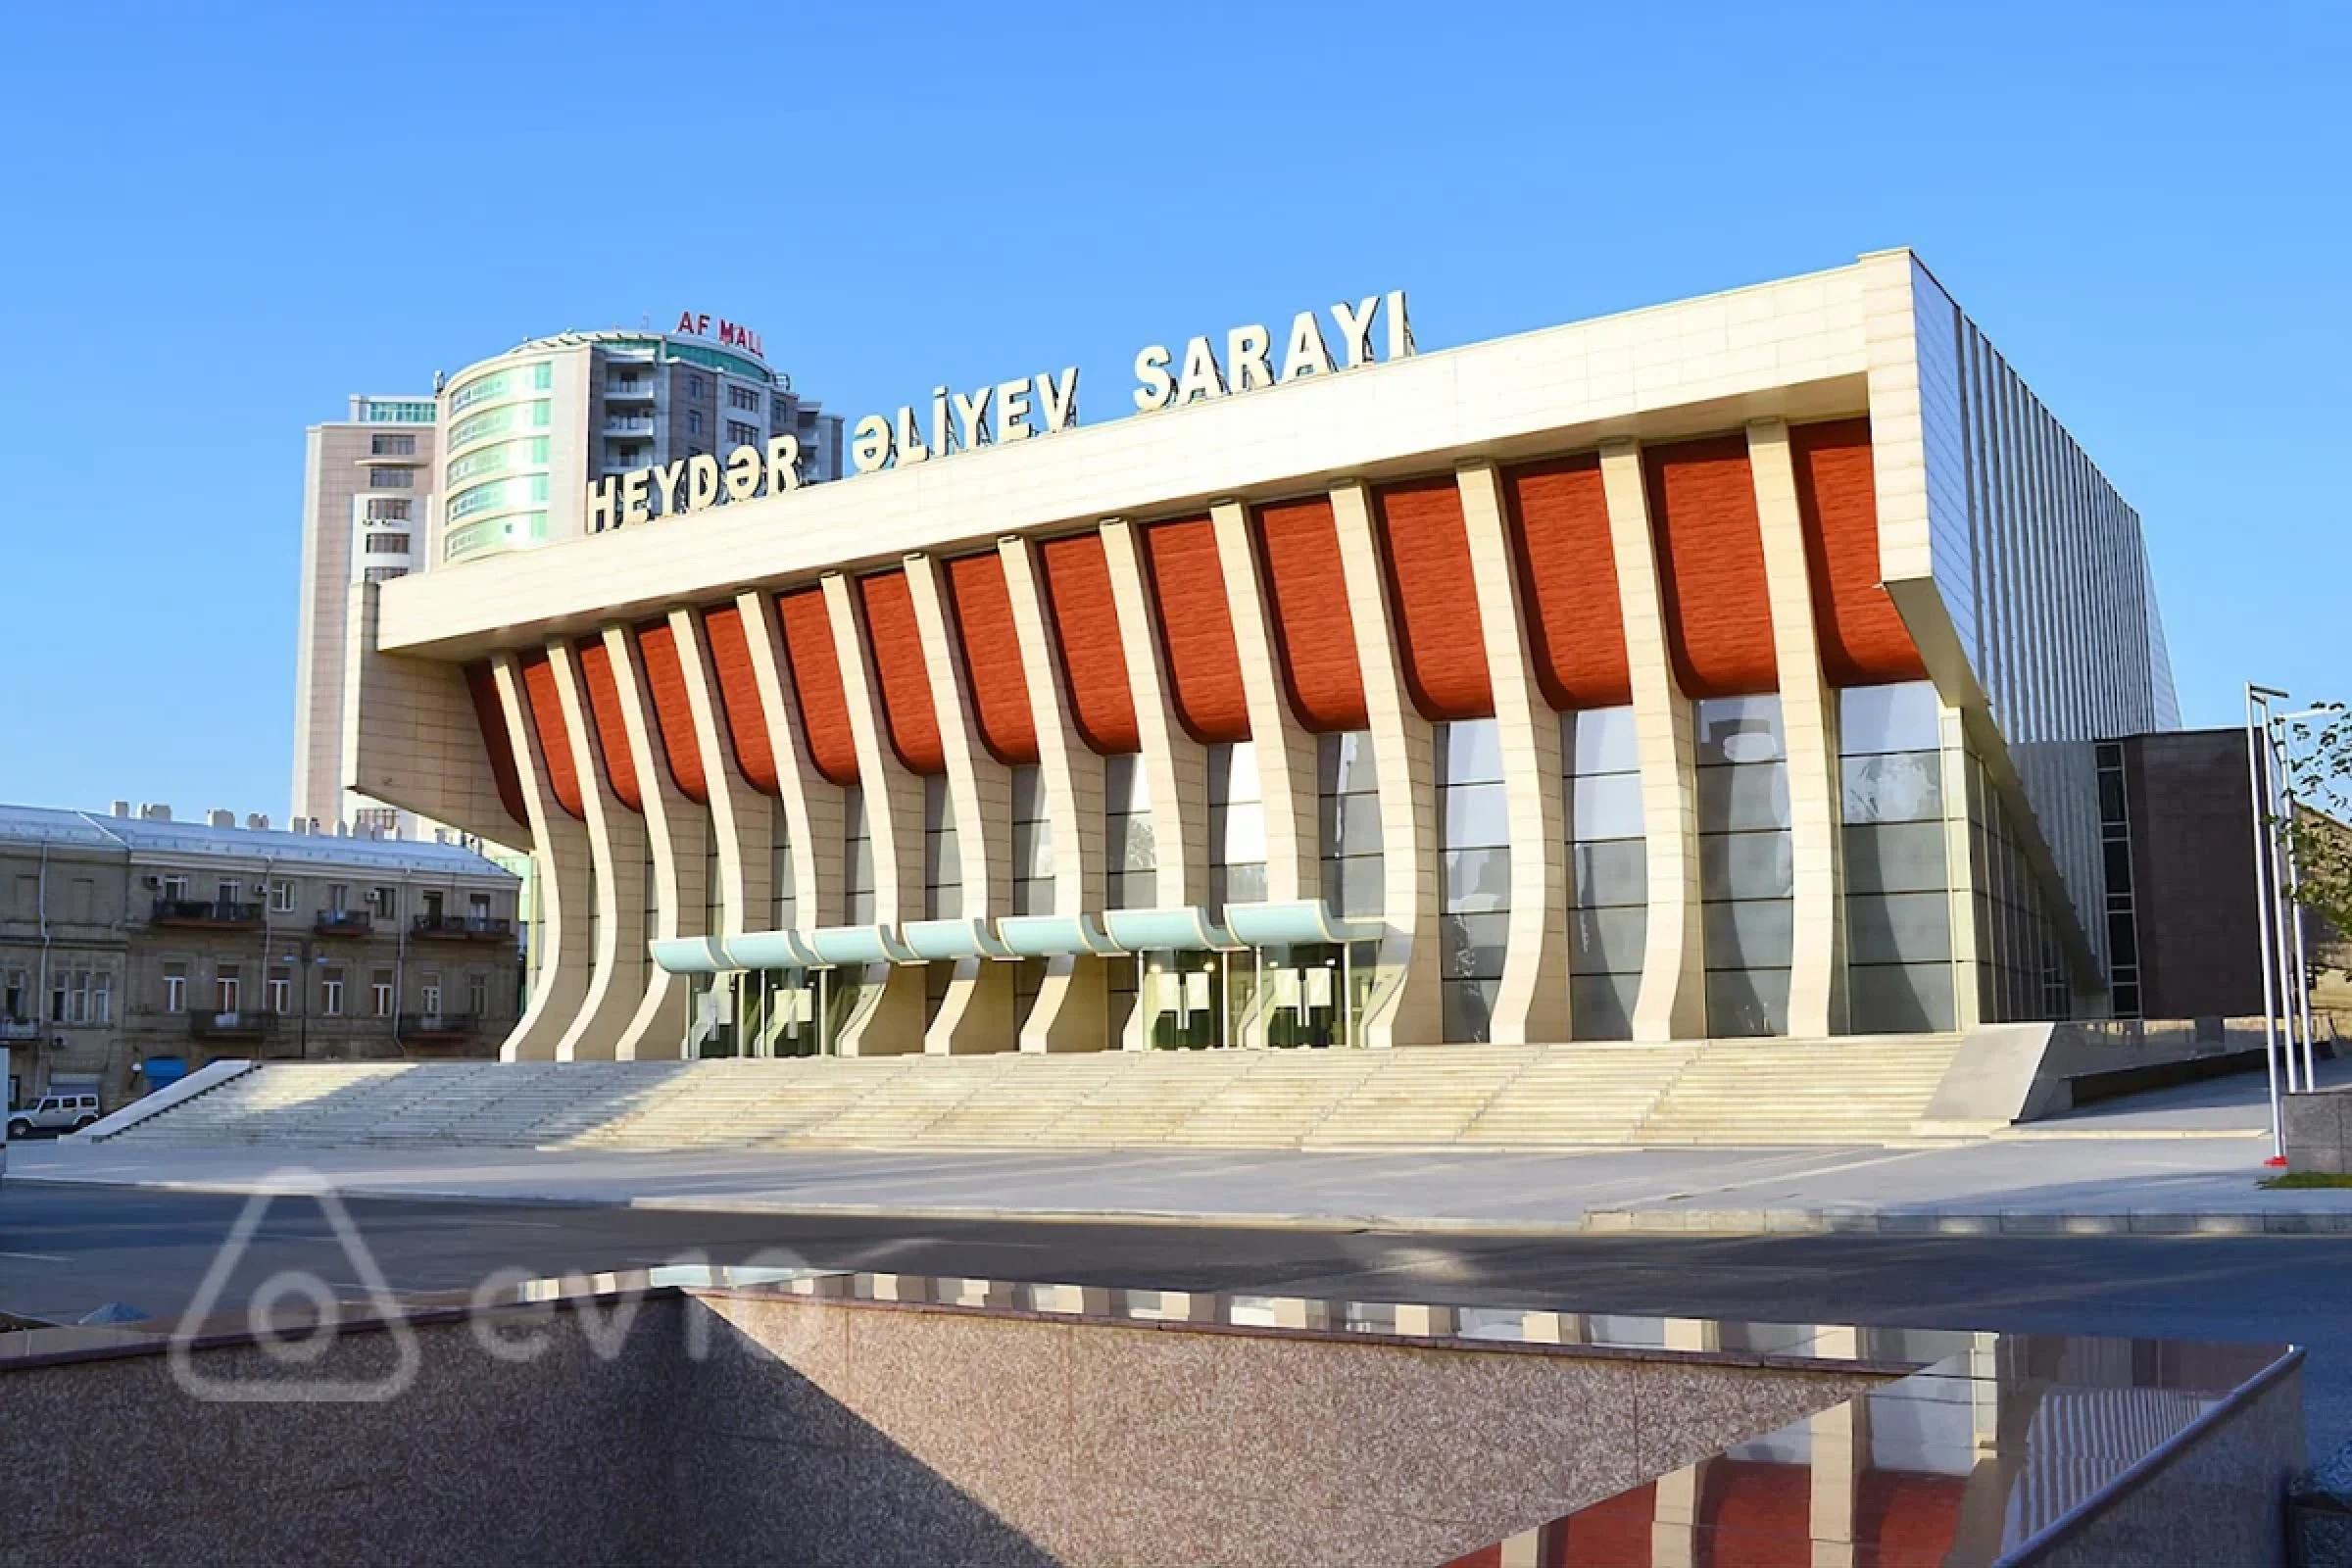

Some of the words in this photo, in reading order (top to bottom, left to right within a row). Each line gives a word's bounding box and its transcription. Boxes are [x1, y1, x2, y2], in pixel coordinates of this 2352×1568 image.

[677, 311, 710, 336] AF
[718, 318, 763, 359] MALL
[585, 434, 801, 535] HEYDƏR
[852, 367, 1079, 473] ƏLİYEV
[1133, 290, 1409, 414] SARAYI
